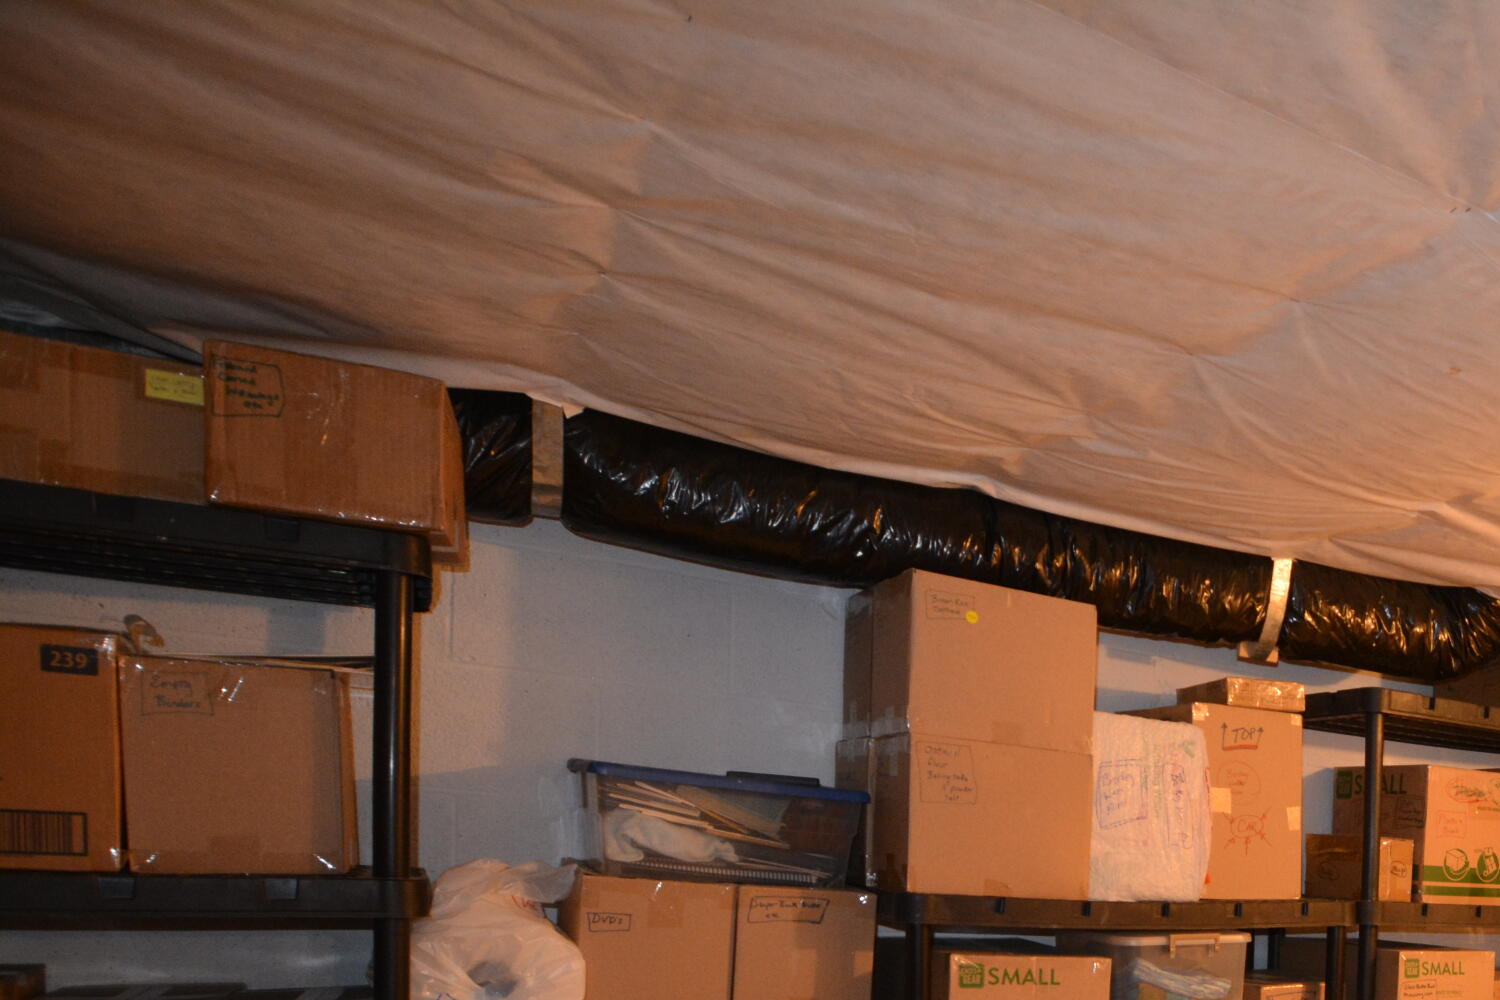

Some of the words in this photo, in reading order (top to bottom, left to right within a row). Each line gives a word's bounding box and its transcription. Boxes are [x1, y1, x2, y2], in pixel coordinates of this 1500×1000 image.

[51, 651, 89, 669] 239
[1232, 727, 1257, 744] TOP
[1354, 773, 1407, 796] SALL
[988, 967, 1061, 986] SMALL
[1422, 961, 1465, 976] SMALL
